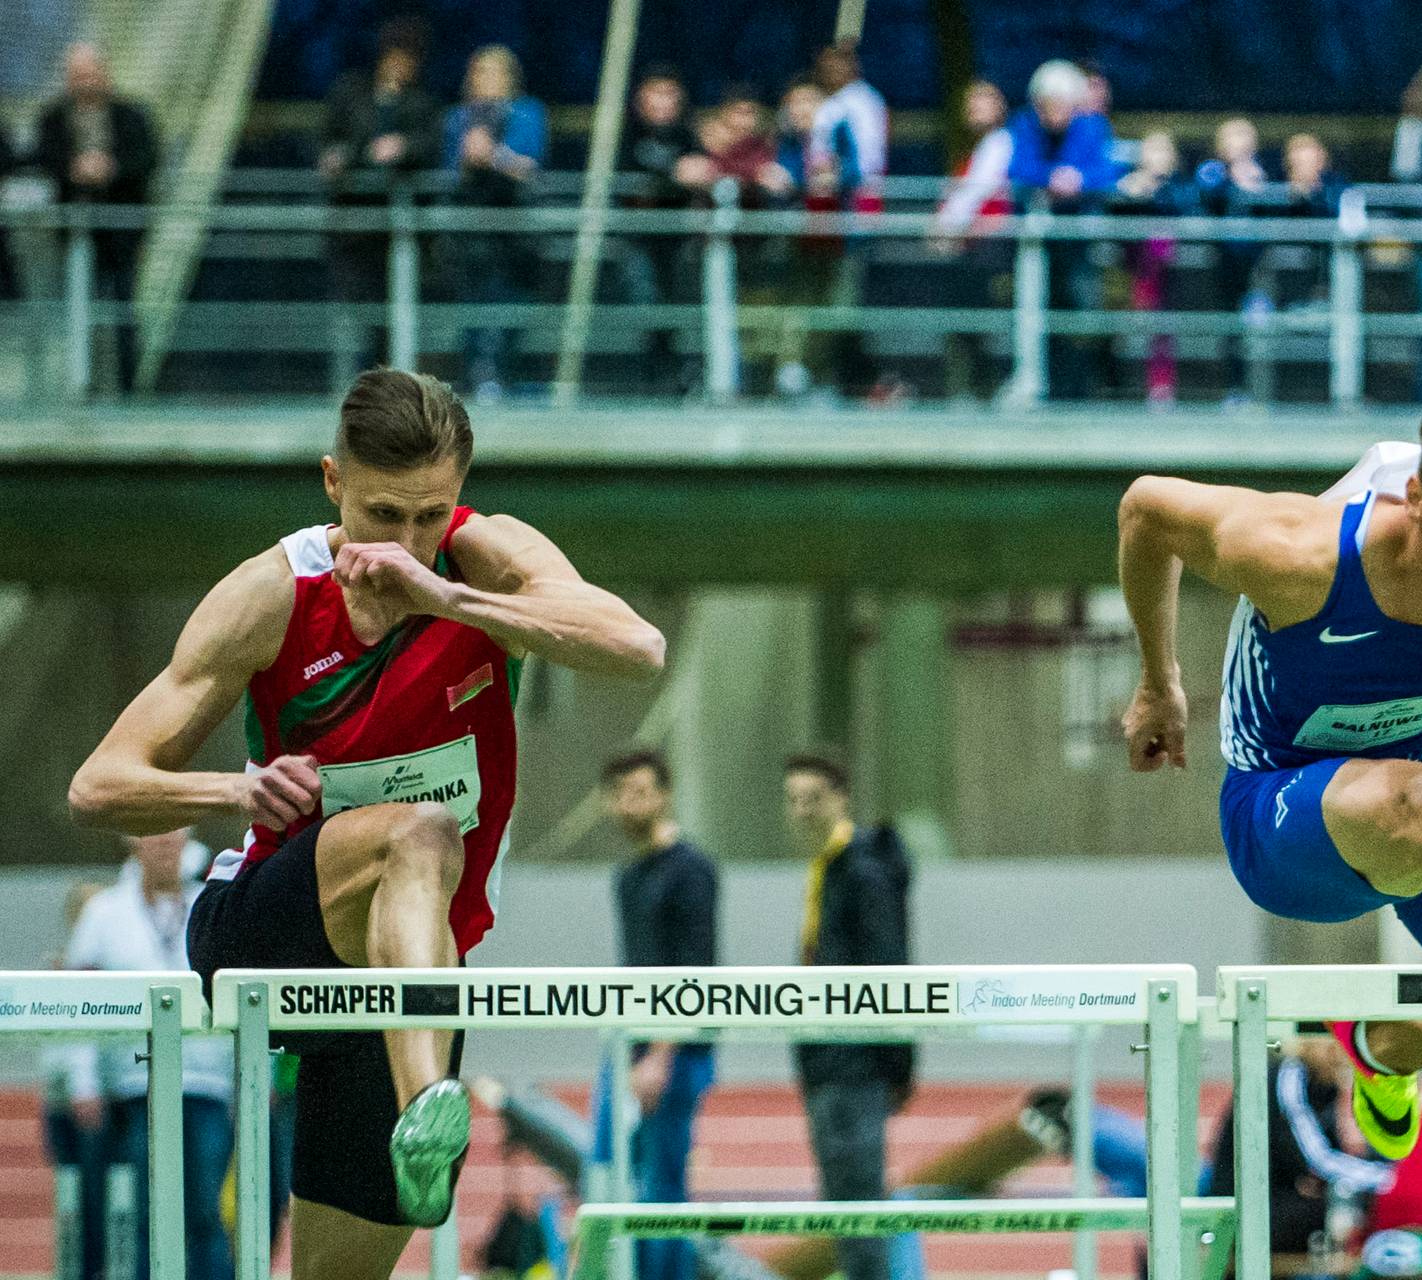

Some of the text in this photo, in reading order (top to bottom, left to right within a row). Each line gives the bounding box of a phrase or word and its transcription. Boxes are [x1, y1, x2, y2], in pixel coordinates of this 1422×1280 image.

[30, 1002, 77, 1018] Meeting
[81, 1001, 142, 1015] Dortmund
[281, 979, 1136, 1016] SCHÄPER HELMUT-KÖRNIG-HALLE Indoor Meeting Dortmund
